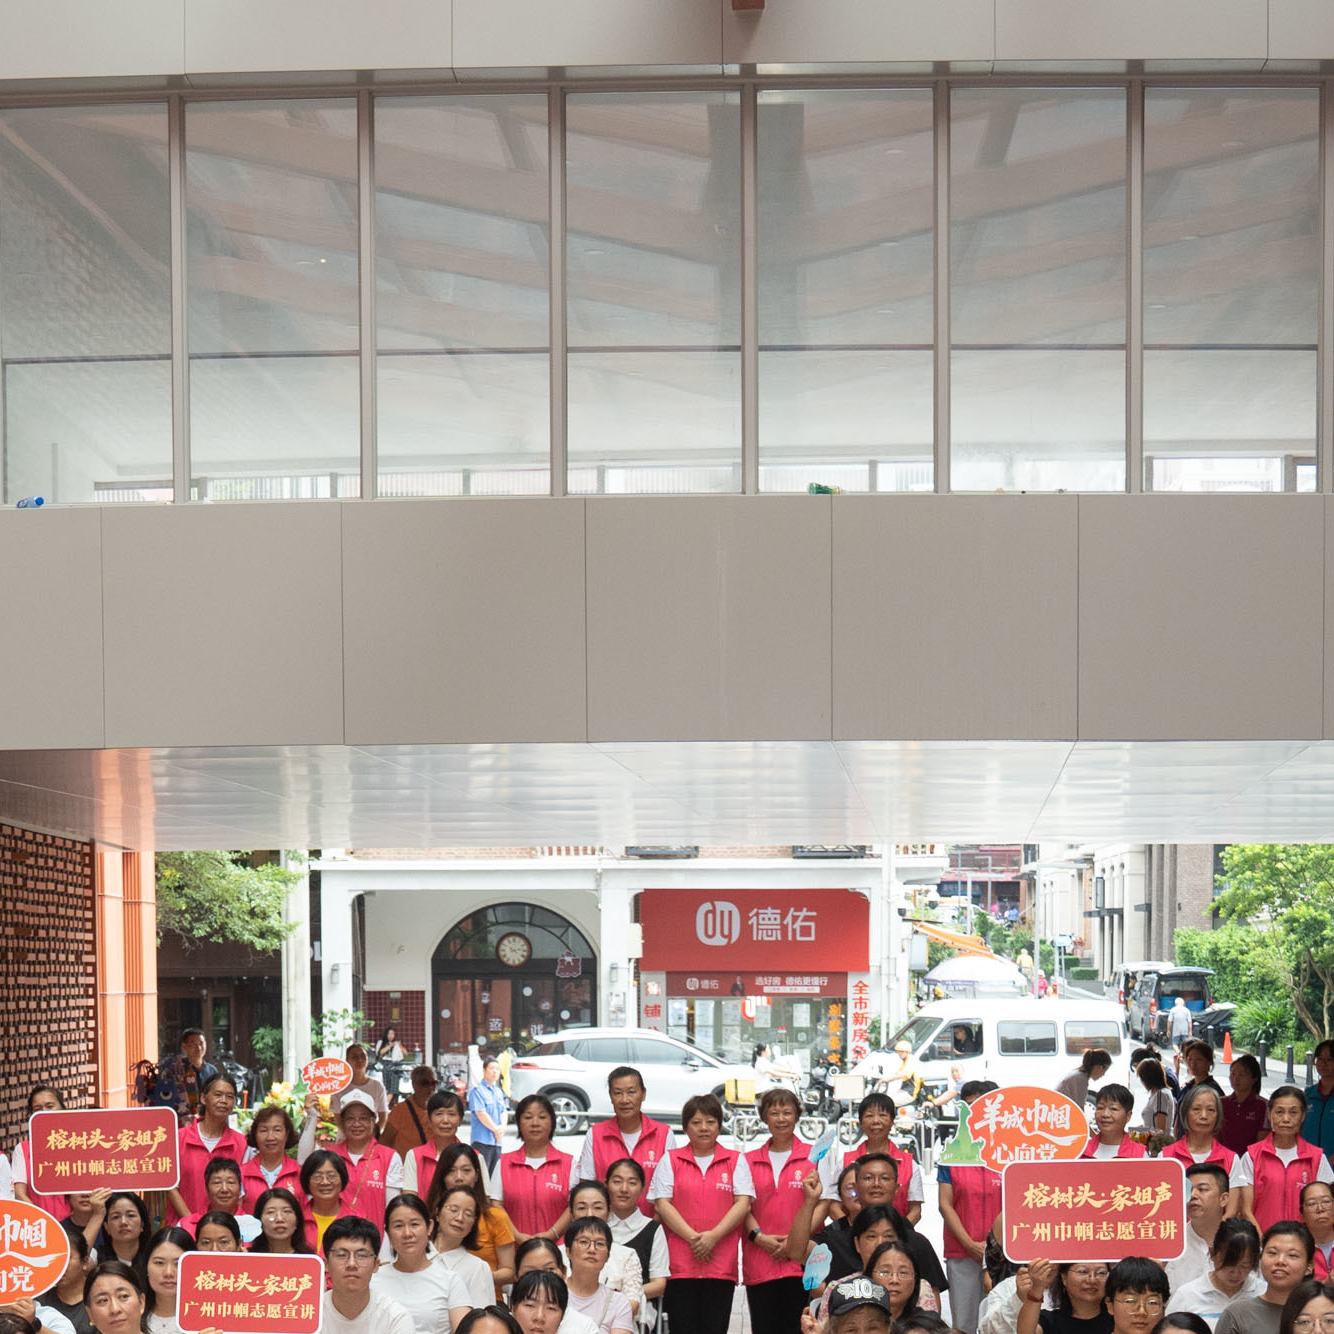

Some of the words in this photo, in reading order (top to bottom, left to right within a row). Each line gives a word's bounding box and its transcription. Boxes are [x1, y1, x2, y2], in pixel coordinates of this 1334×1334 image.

[748, 907, 817, 942] 德佑
[974, 1094, 1077, 1145] 羊城巾帼
[46, 1126, 168, 1156] 榕树头·家姐声
[991, 1143, 1058, 1164] 心向党
[38, 1157, 172, 1177] 广州巾帼志愿宣讲
[1022, 1181, 1172, 1219] 榕树头·家姐声
[1011, 1220, 1178, 1242] 广州巾帼志愿宣讲
[193, 1270, 313, 1302] 榕树头·家姐声
[183, 1301, 315, 1319] 广州巾帼志愿宣讲
